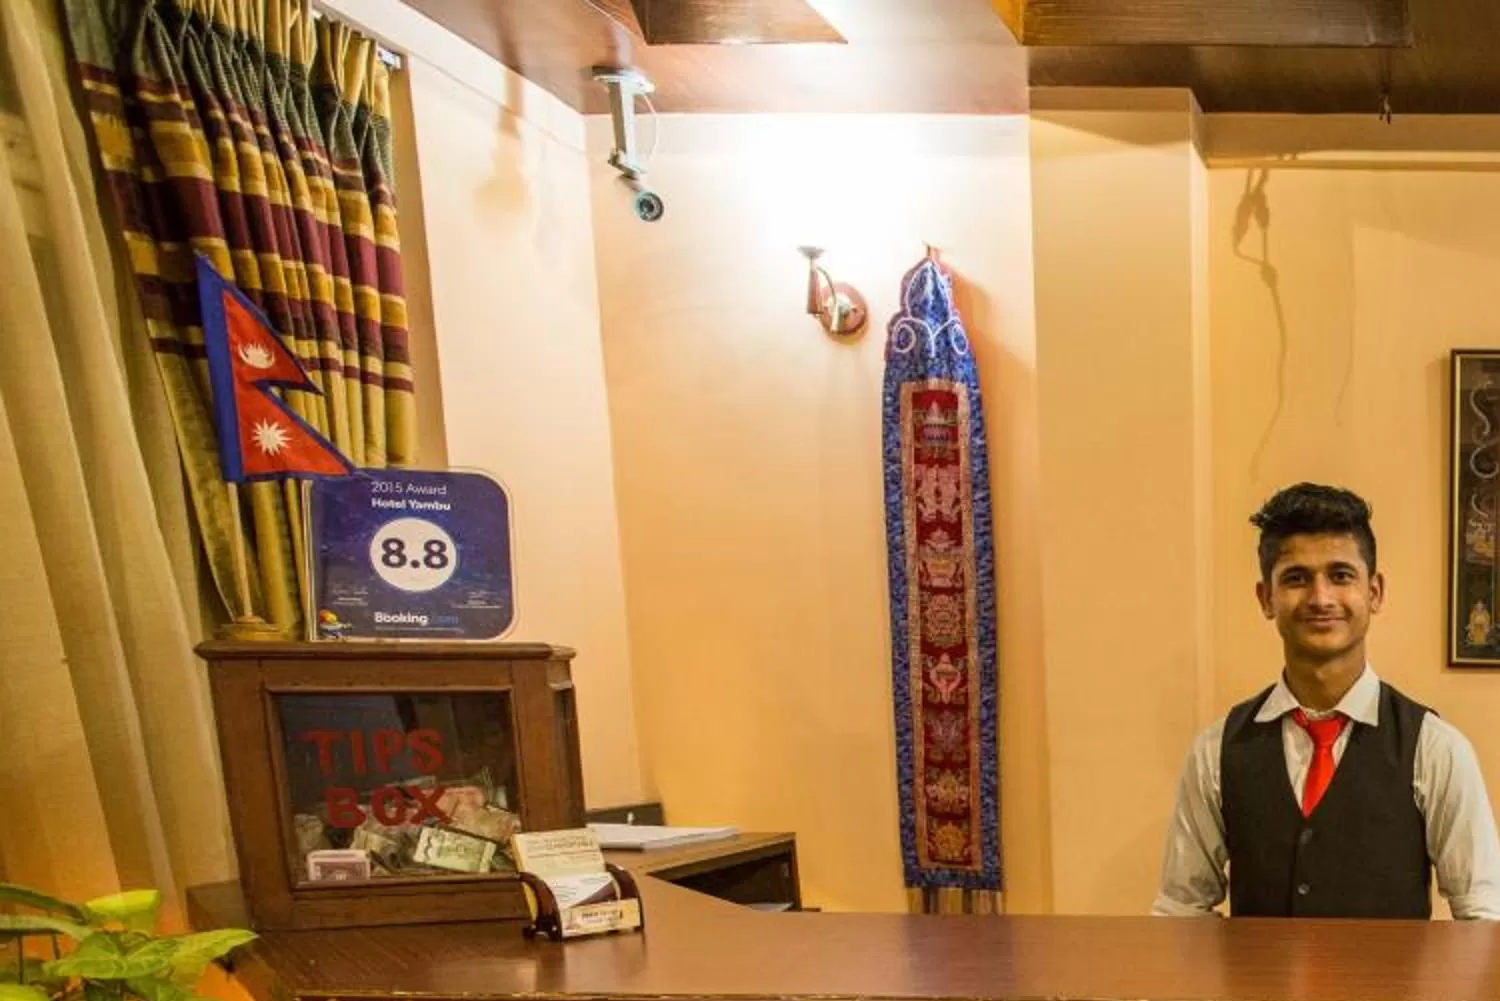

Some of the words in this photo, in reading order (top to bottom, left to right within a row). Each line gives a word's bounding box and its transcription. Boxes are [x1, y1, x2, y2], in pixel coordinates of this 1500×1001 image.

[371, 481, 402, 494] 2015
[406, 483, 447, 495] Award
[371, 498, 406, 509] Hotel
[408, 499, 452, 511] Yambu
[381, 538, 449, 569] 8.8
[299, 728, 446, 781] TIPS
[322, 784, 452, 828] BOX
